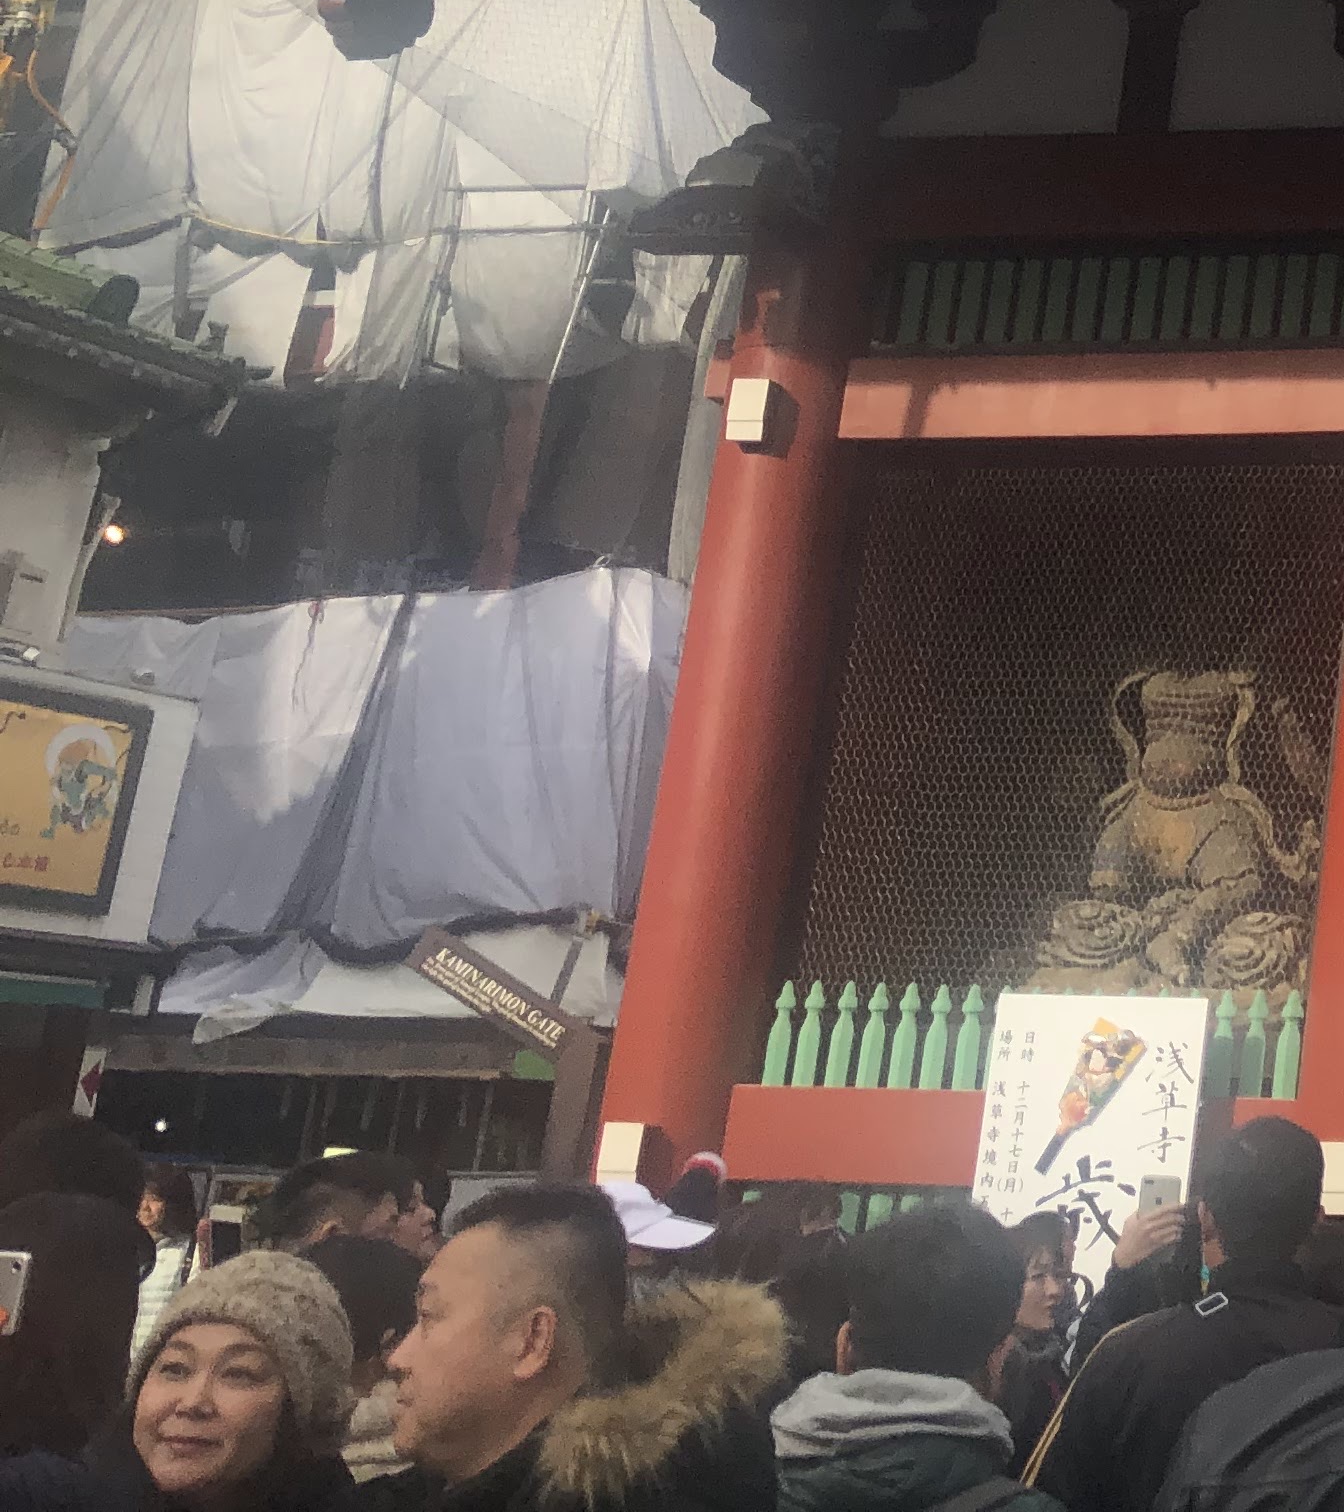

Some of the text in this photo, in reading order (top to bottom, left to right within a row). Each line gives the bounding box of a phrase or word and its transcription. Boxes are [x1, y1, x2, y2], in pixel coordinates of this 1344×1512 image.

[436, 947, 531, 1016] KAMINARIMON
[527, 1009, 566, 1041] GATE
[997, 1029, 1013, 1062] 場所
[1020, 1031, 1036, 1064] 日時
[1137, 1042, 1195, 1164] 浅草寺
